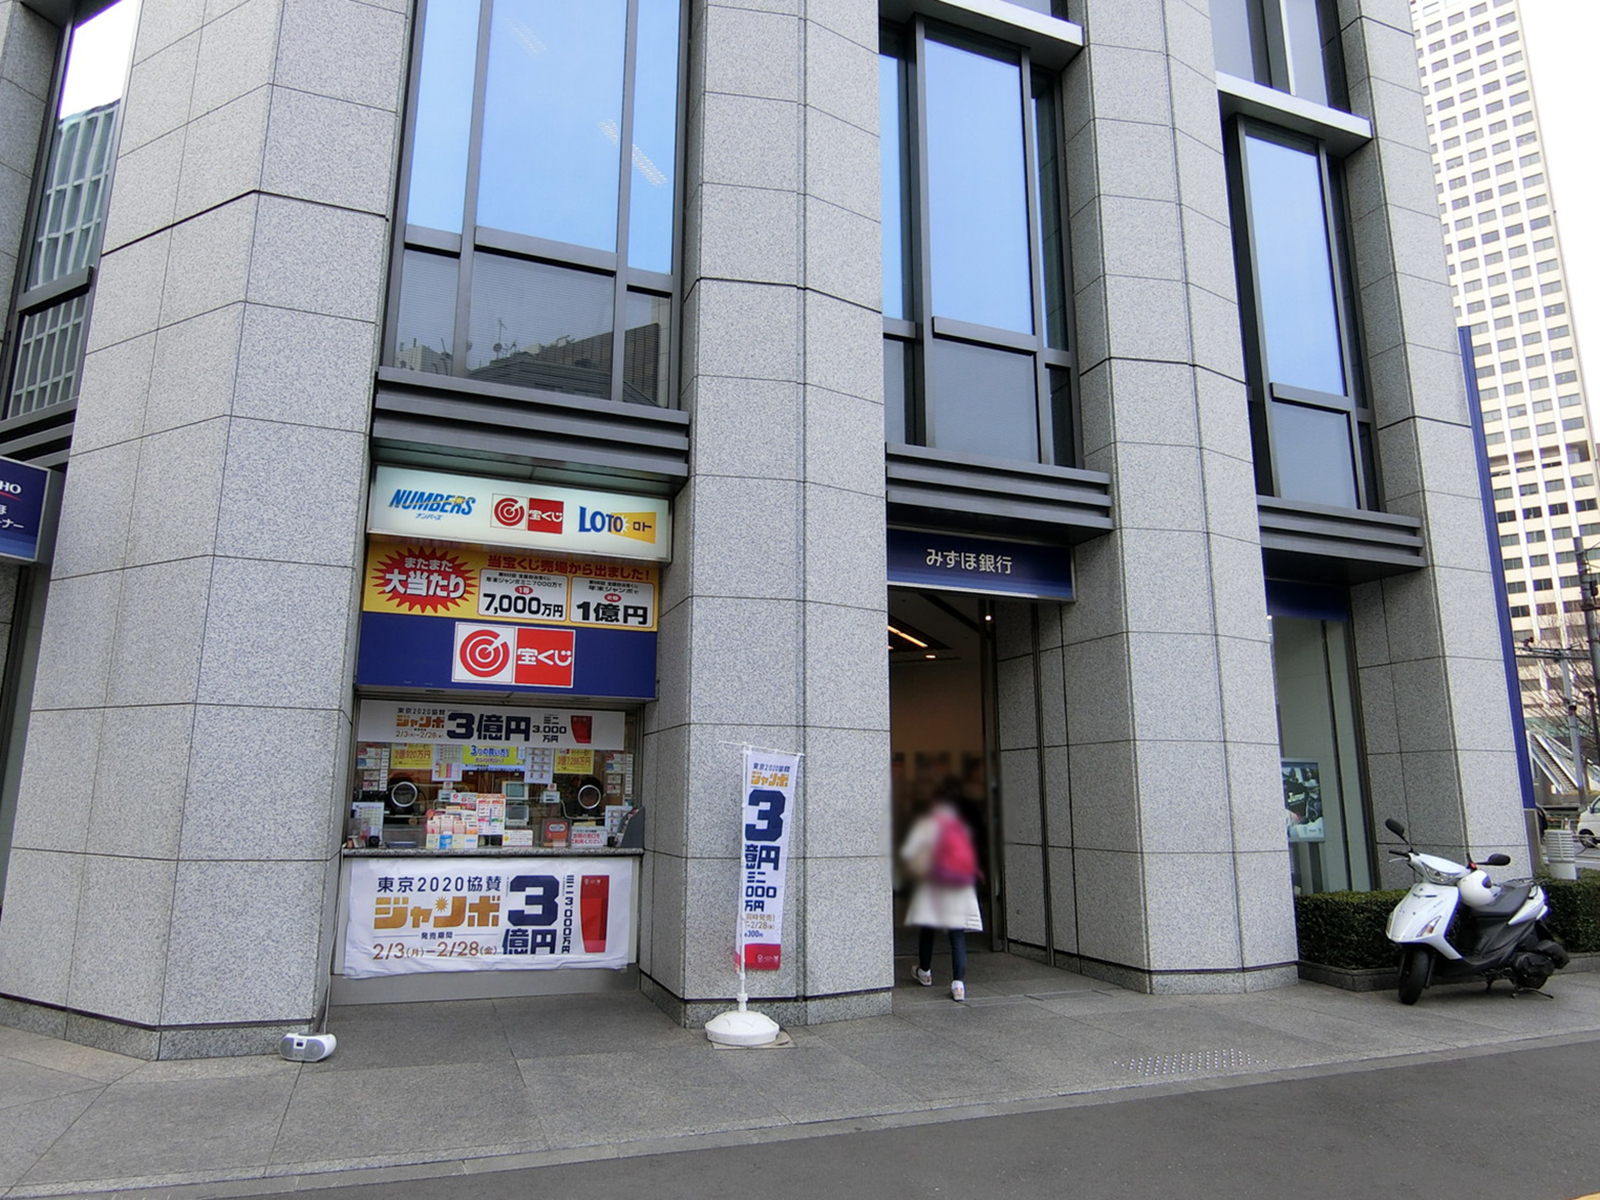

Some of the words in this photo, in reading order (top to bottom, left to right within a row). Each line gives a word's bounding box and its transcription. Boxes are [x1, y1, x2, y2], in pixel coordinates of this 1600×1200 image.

[389, 489, 476, 515] NUMBERS
[529, 509, 562, 523] 宝くじ
[578, 506, 623, 532] LOTO
[632, 521, 652, 532] ロト
[404, 557, 453, 572] またまた
[926, 549, 1012, 574] みずほ銀行
[384, 569, 466, 598] 大当たり
[482, 593, 564, 618] 7,000万円
[576, 601, 648, 625] 1億円
[517, 647, 572, 666] 宝くじ
[396, 714, 445, 729] ジャンボ
[397, 707, 445, 716] 東京2020協賛
[447, 712, 532, 741] 3億円
[542, 735, 559, 743] 万円
[745, 789, 786, 842] 3
[377, 876, 501, 893] 東京2020協賛
[373, 895, 501, 929] ジャンボ
[507, 875, 560, 927] 3
[745, 900, 764, 912] 万円
[421, 931, 453, 940] 発売期間
[502, 928, 557, 955] 億円
